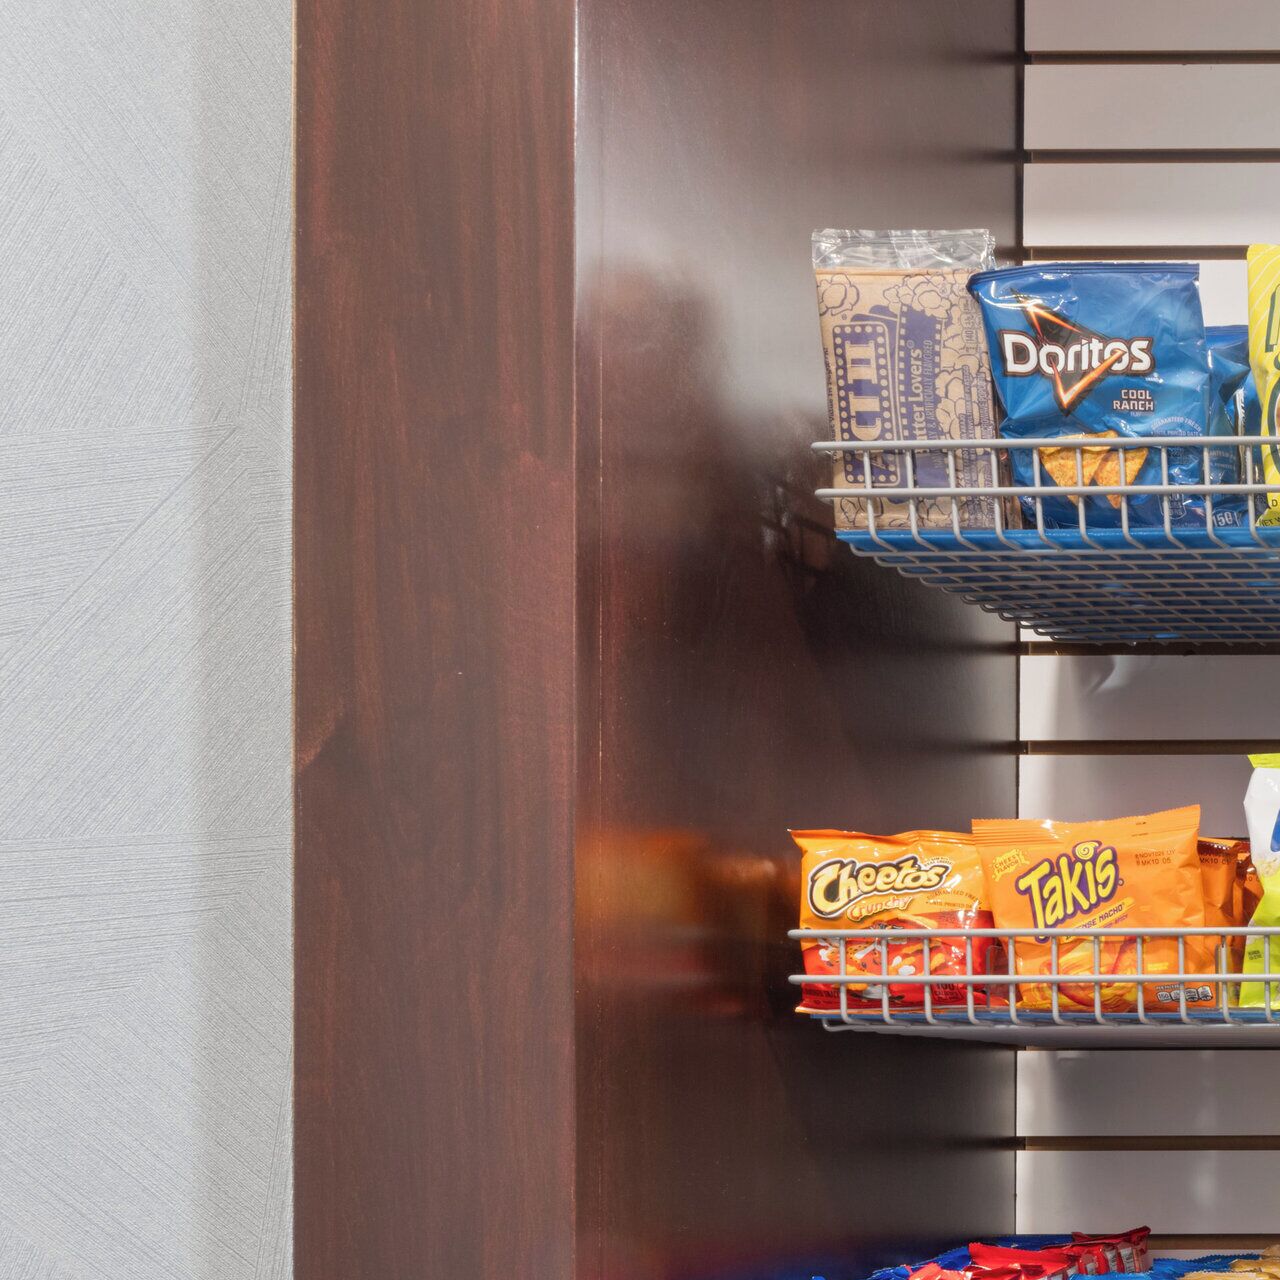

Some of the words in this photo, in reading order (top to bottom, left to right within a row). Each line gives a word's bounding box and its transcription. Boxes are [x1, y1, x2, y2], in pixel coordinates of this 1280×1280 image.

[909, 348, 923, 402] Lovers
[1004, 332, 1152, 376] Doritos
[1113, 400, 1154, 411] RANCH
[1121, 389, 1152, 399] COOL
[810, 857, 948, 919] Cheetos
[847, 895, 914, 920] Crunchy
[1018, 842, 1117, 939] Takis
